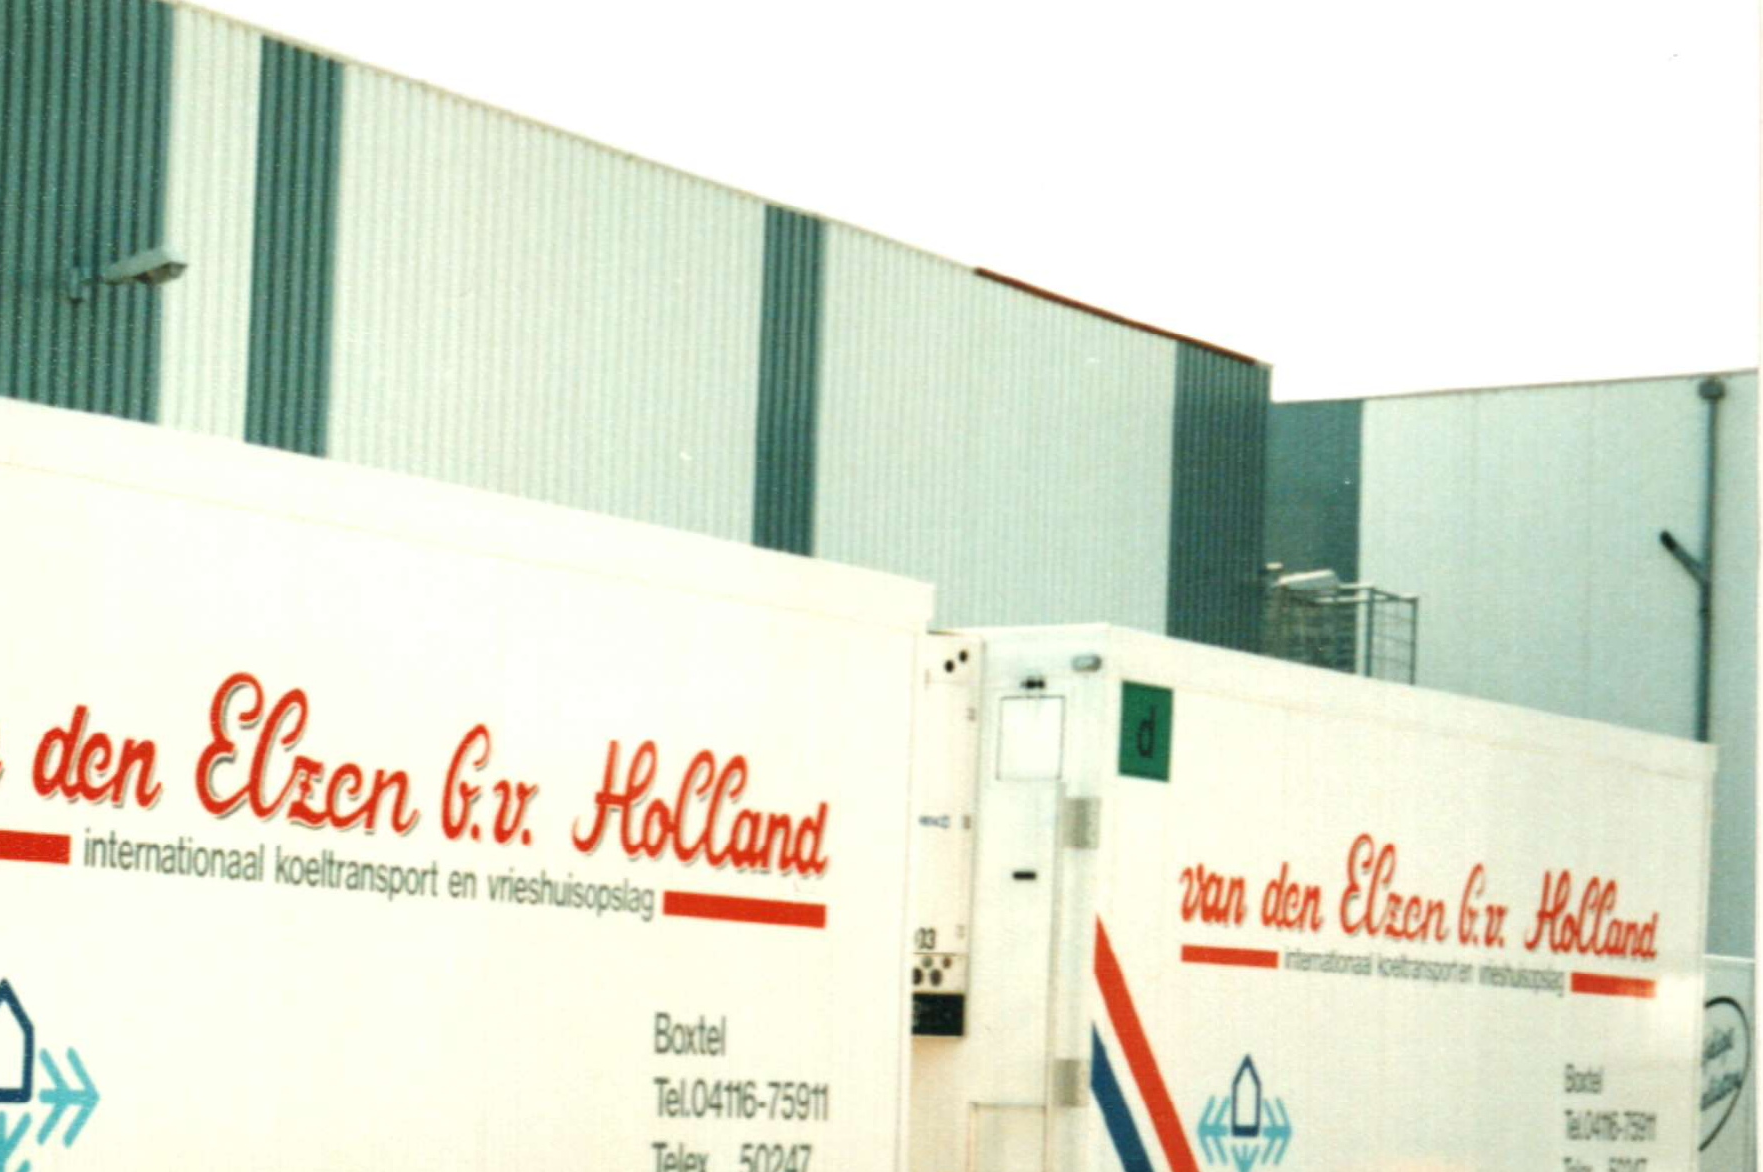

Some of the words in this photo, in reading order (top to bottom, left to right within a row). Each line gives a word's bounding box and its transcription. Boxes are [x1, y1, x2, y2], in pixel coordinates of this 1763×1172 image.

[32, 704, 163, 809] den
[194, 671, 420, 836] Elzen
[572, 740, 829, 878] Holland
[83, 829, 265, 882] internationaal
[275, 846, 439, 902] koeltransport
[448, 869, 478, 900] en
[487, 867, 655, 922] vrieshuisopslag
[1179, 863, 1247, 926] van
[1260, 861, 1324, 932] den
[1340, 833, 1450, 945] Elzen
[1524, 869, 1659, 961] Holland
[653, 1011, 727, 1056] Boxtel
